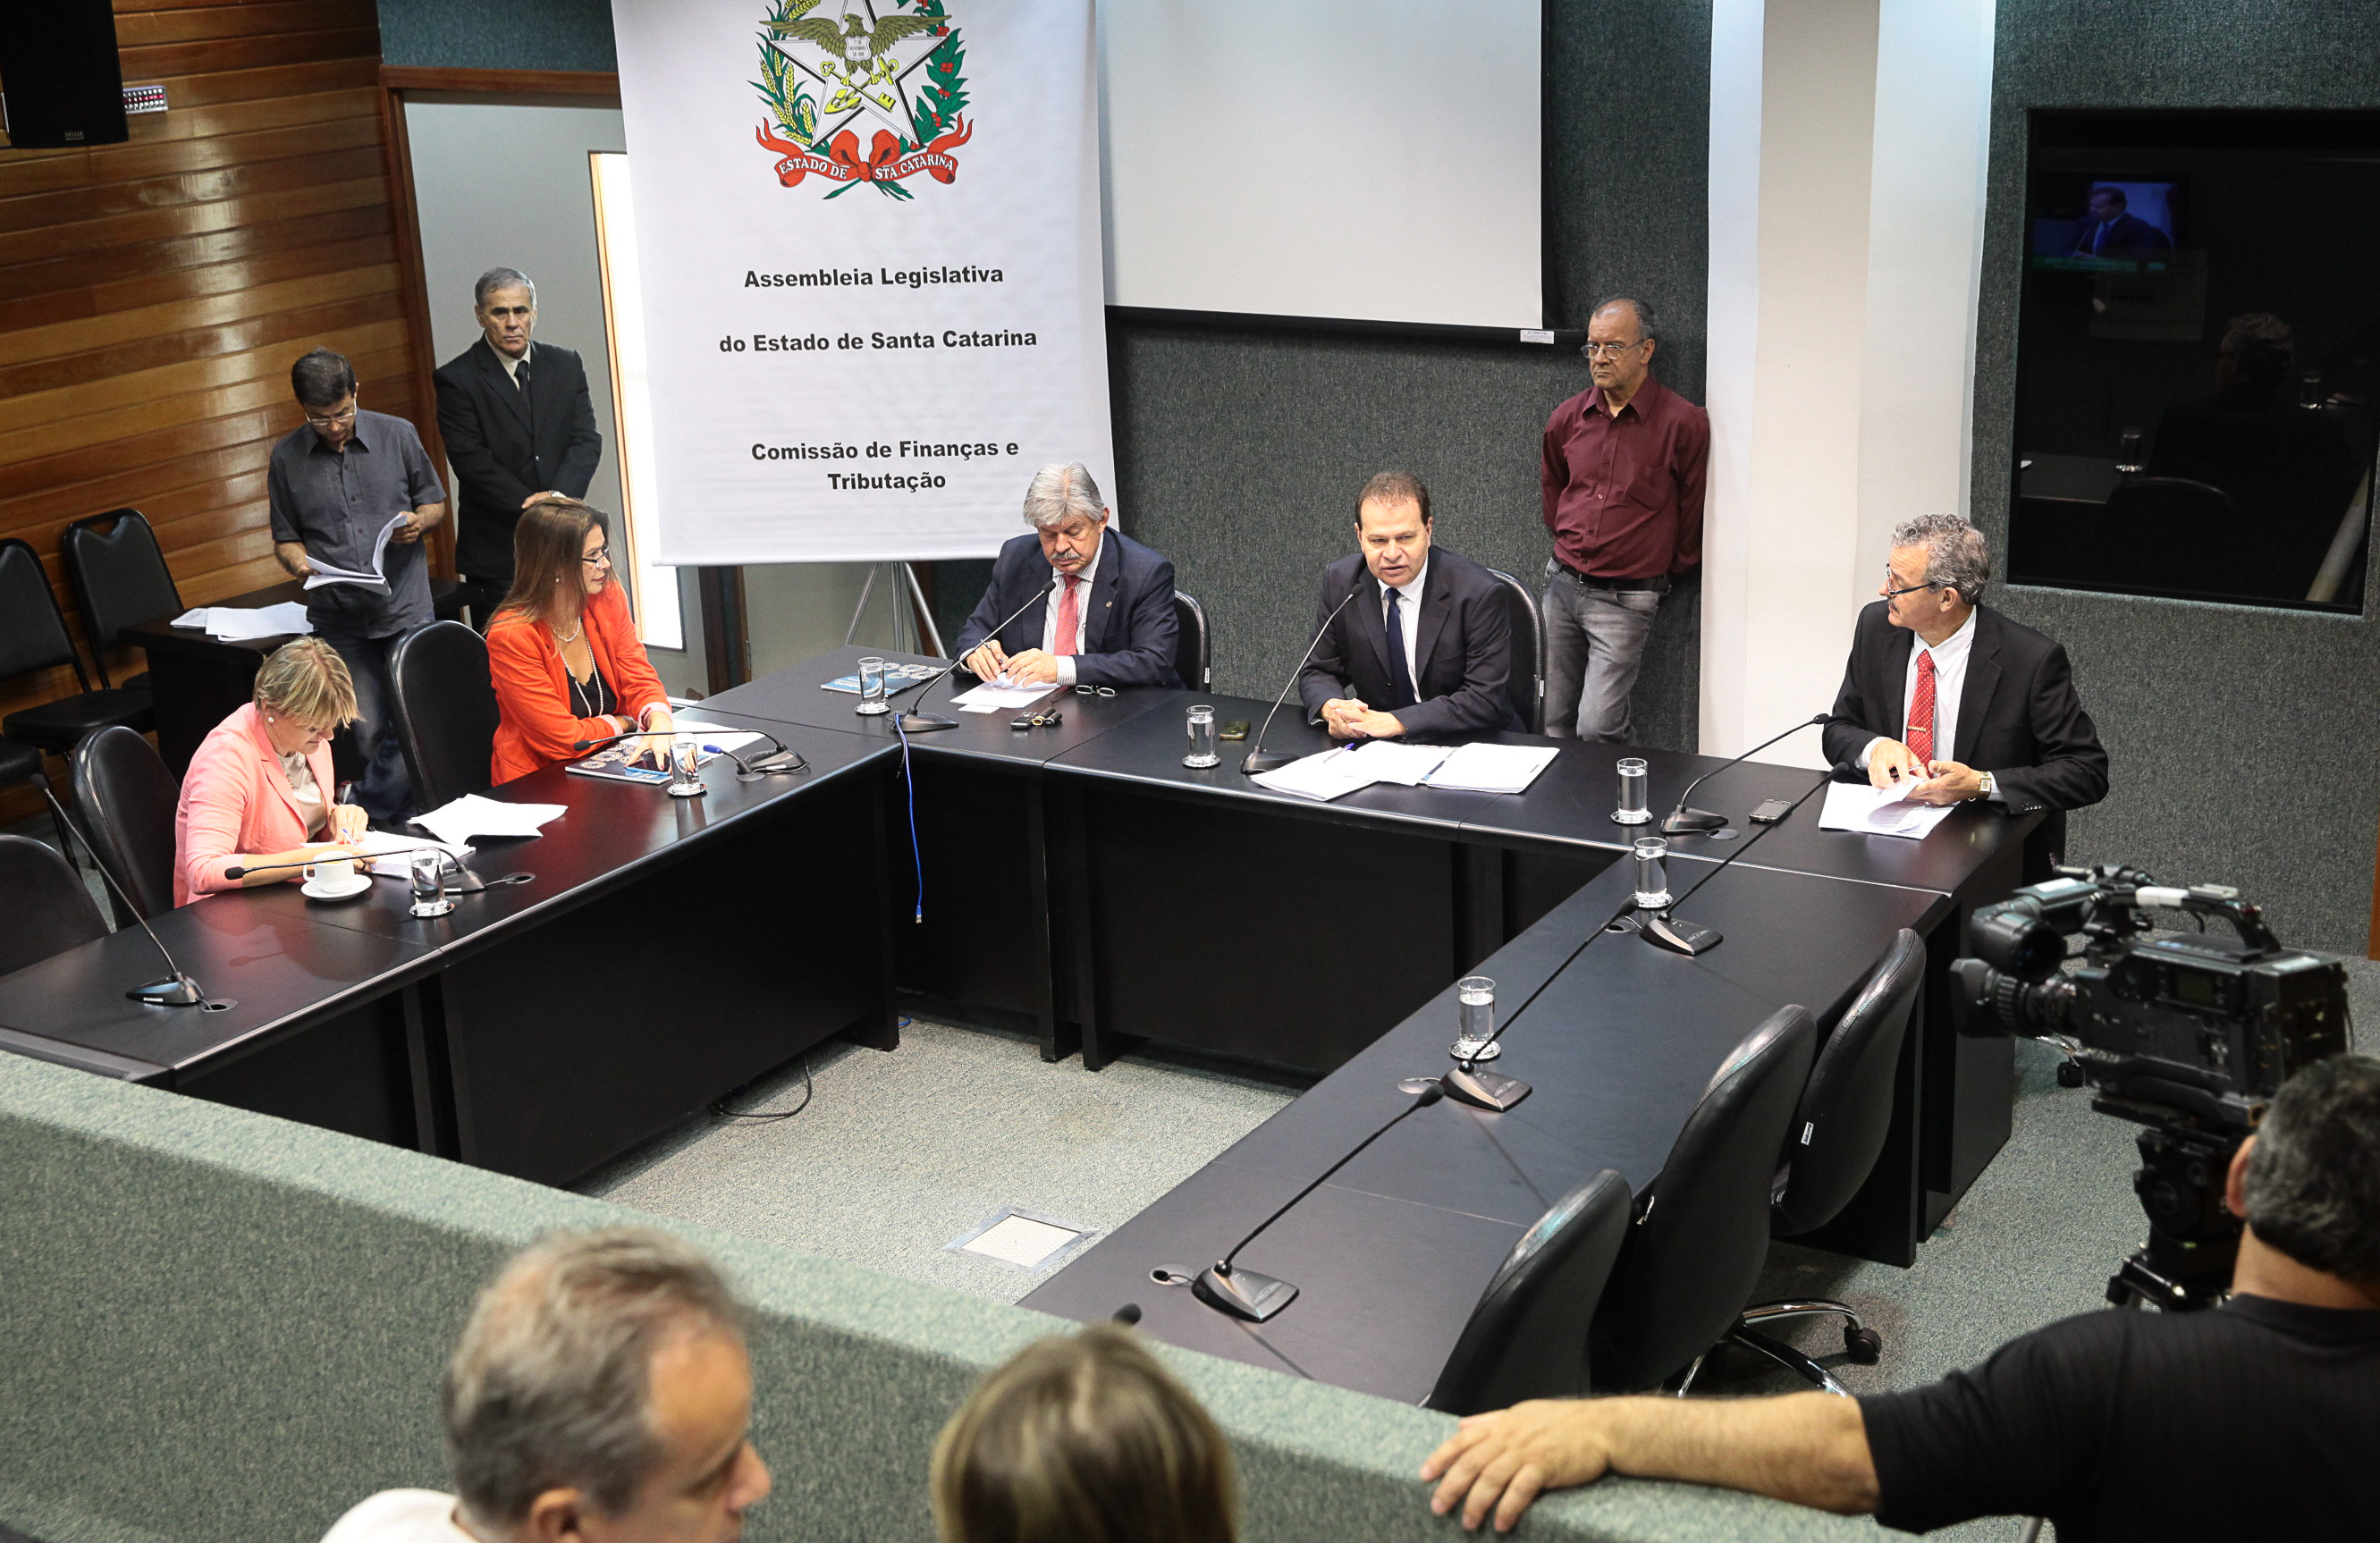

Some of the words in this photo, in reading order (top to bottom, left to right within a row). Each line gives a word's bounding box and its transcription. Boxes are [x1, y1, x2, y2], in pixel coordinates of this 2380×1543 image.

[779, 157, 828, 174] ESTADO
[830, 164, 848, 179] DE
[874, 167, 900, 180] STA.
[899, 154, 954, 173] CATARINA
[744, 268, 874, 288] Assembleia
[881, 265, 1004, 289] Legislativa
[719, 335, 746, 353] do
[753, 333, 830, 352] Estado
[837, 333, 864, 350] de
[871, 332, 935, 350] Santa
[942, 329, 1037, 348] Catarina
[751, 442, 858, 460] Comissão
[865, 441, 892, 459] de
[899, 440, 999, 461] Finanças
[1006, 443, 1019, 456] e
[827, 471, 946, 493] Tributação
